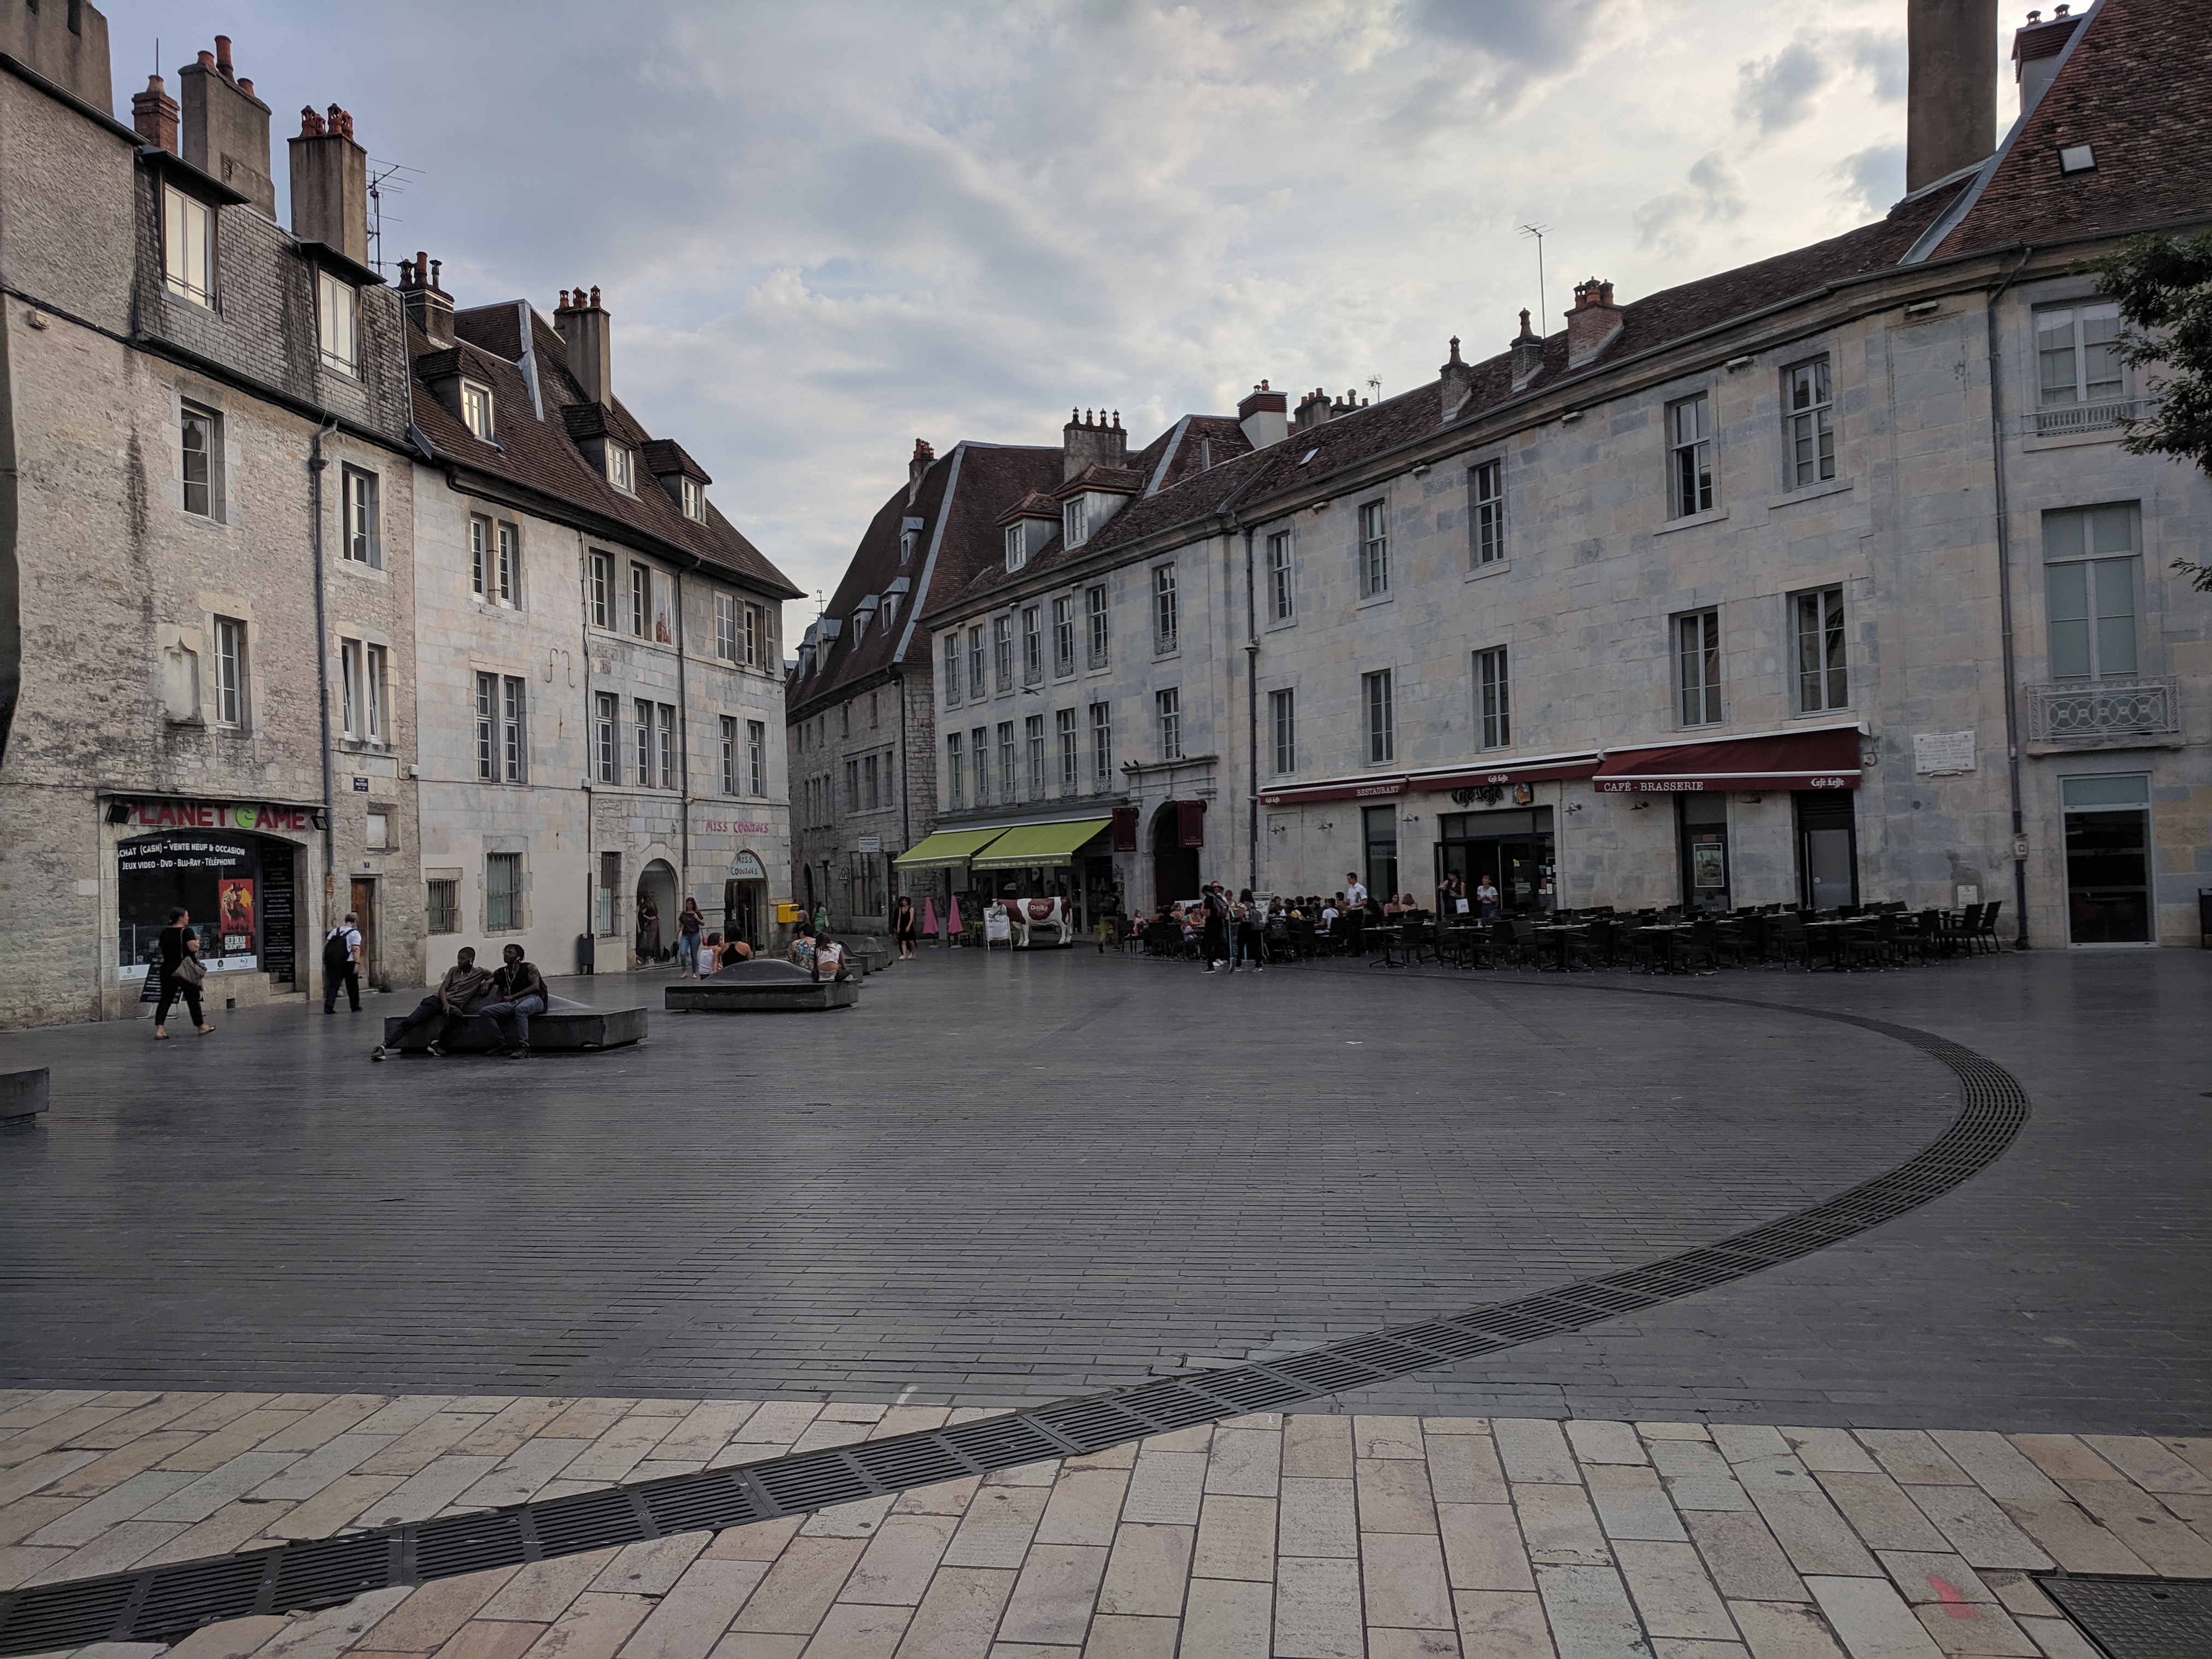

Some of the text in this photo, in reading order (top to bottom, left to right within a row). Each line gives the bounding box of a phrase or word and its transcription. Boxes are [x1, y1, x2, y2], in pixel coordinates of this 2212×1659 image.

[1604, 781, 1631, 791] CAFÉ
[1640, 781, 1703, 791] BRASSERIE
[1810, 777, 1845, 789] Café Leffe
[1356, 786, 1399, 796] RESTAURANT
[236, 805, 306, 829] GAME
[705, 819, 727, 832] MISS
[140, 843, 162, 856] (CASH)
[215, 845, 245, 856] OCCASION
[122, 861, 137, 870] JEUX
[160, 859, 173, 867] DVD
[205, 857, 236, 866] TÉLÉPHONIE
[736, 855, 753, 864] MISS
